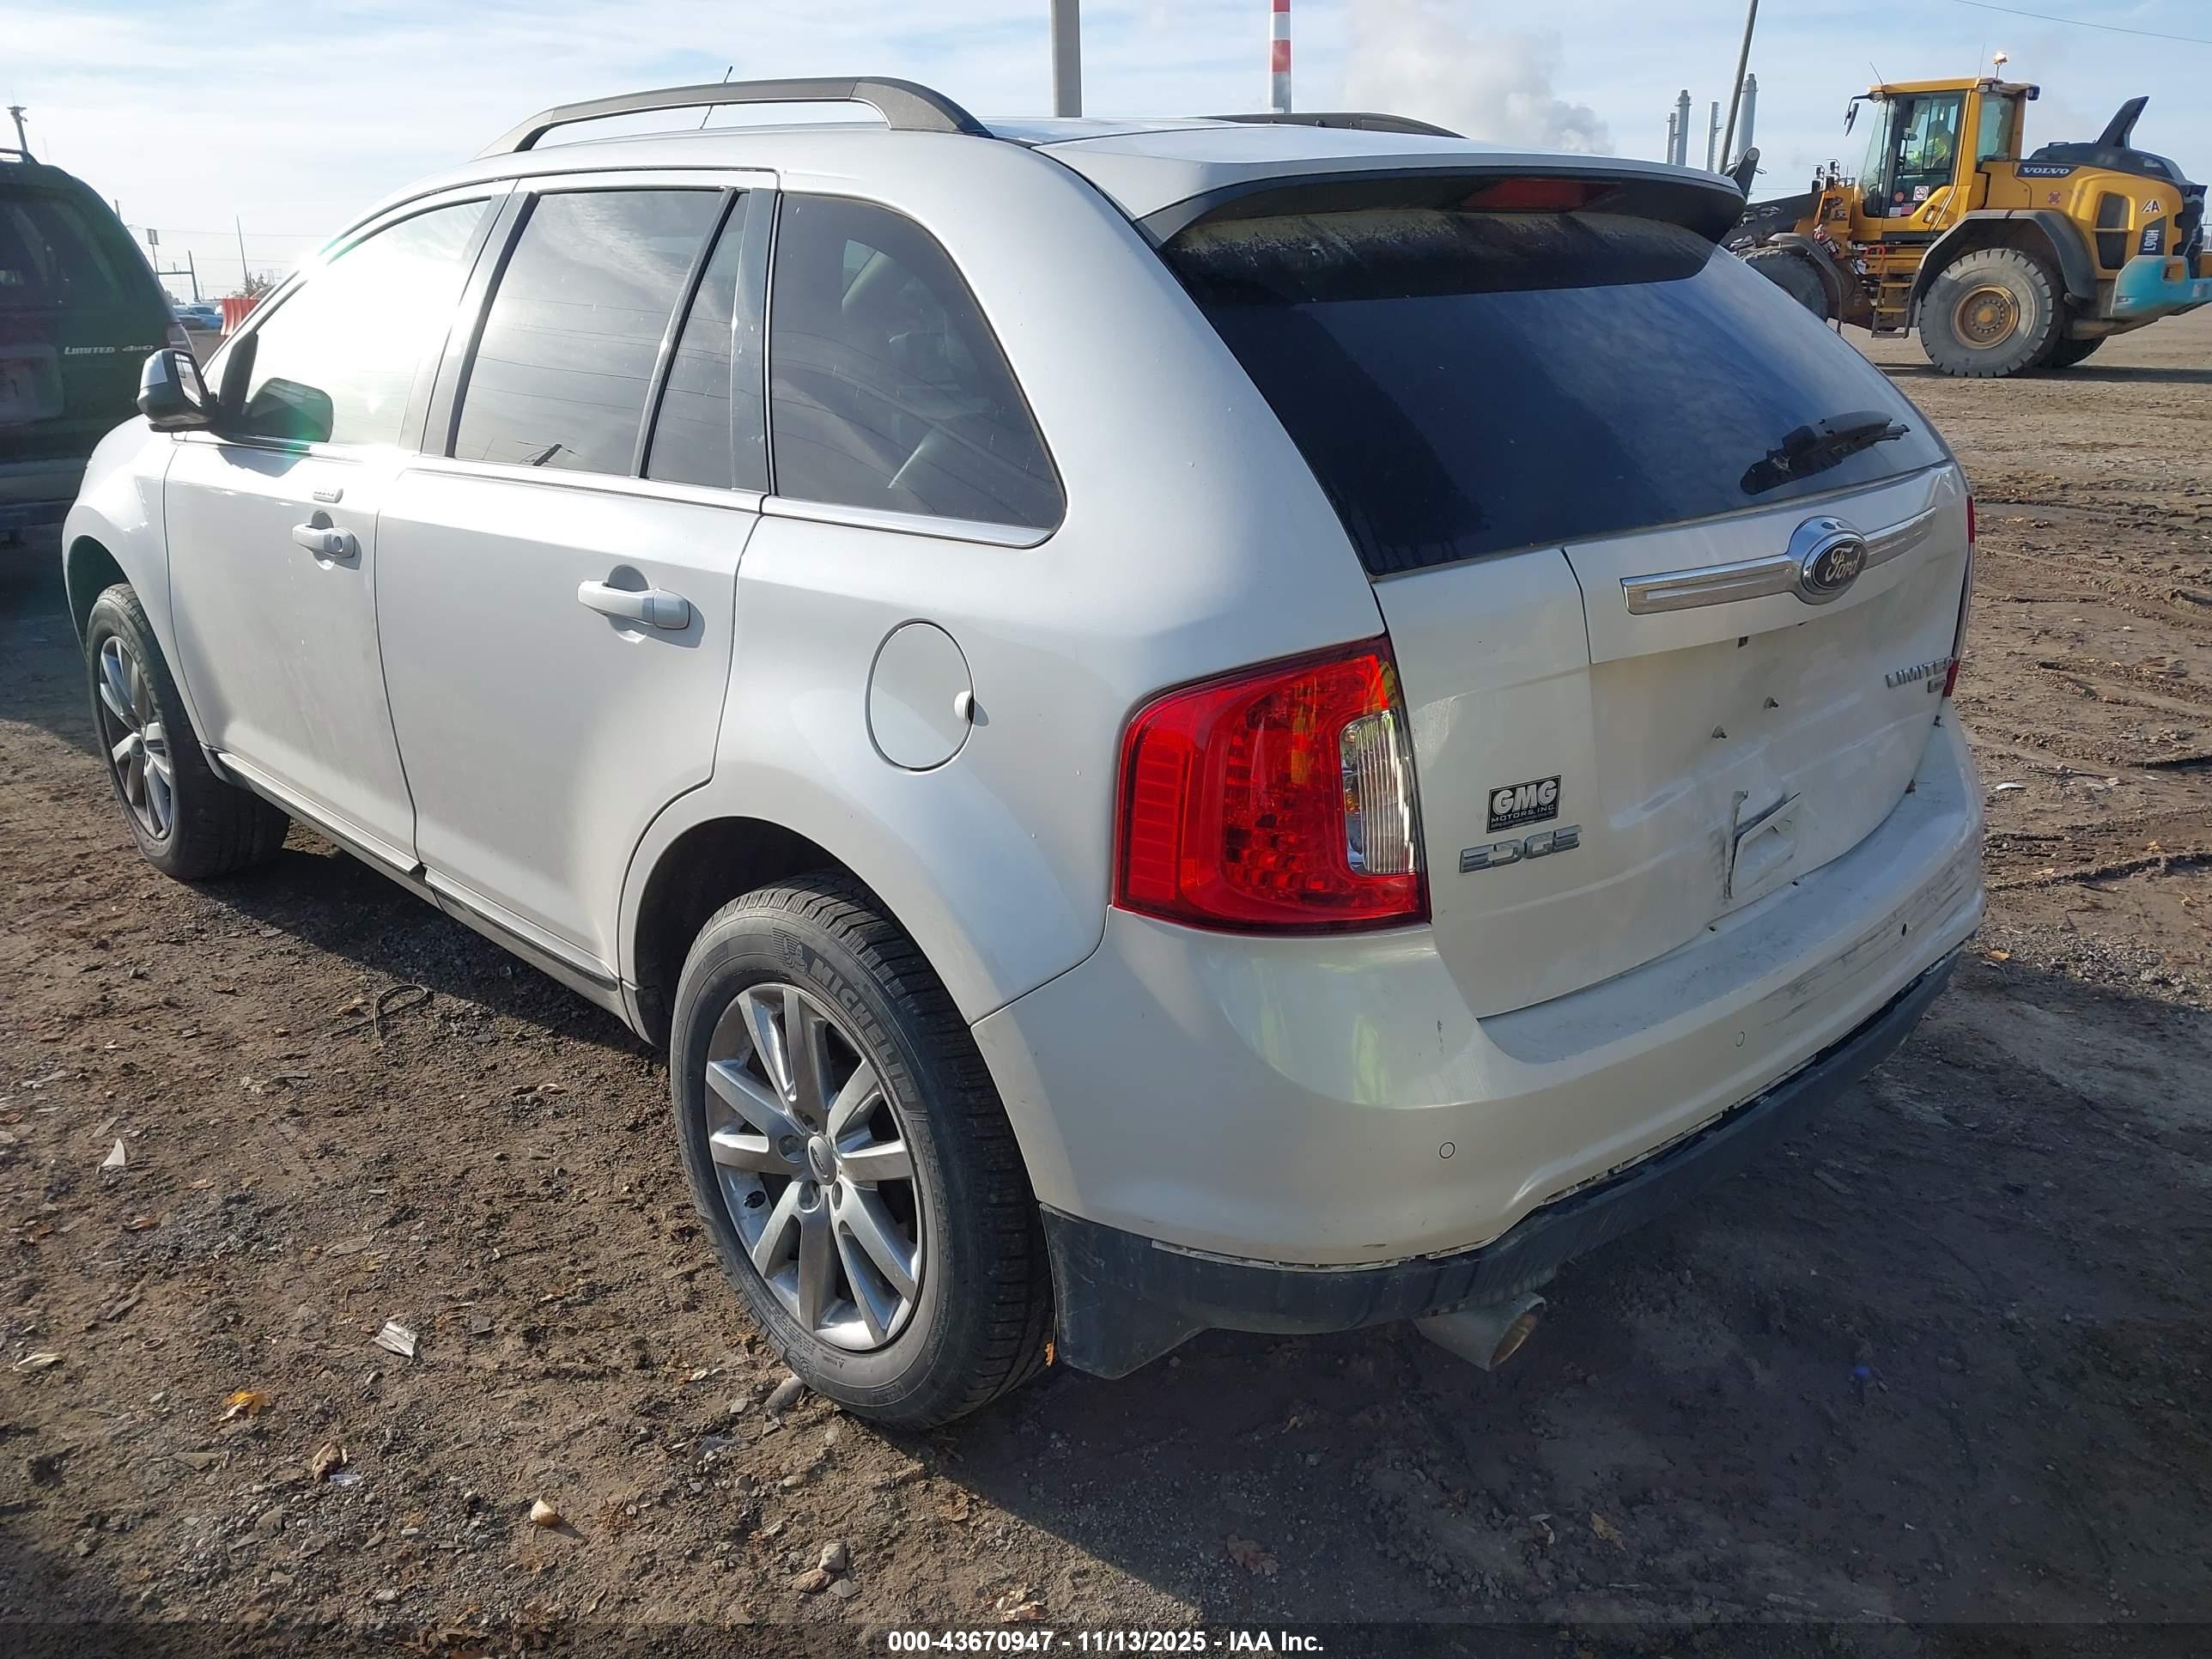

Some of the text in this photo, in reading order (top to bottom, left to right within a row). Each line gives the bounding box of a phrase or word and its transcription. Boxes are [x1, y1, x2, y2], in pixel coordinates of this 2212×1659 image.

[2143, 229, 2160, 251] L90H
[64, 346, 115, 355] LIMITED
[1825, 544, 1861, 581] Ford
[1492, 780, 1558, 816] GMG
[1460, 824, 1582, 873] EDGE
[810, 957, 917, 1103] MICHELIN
